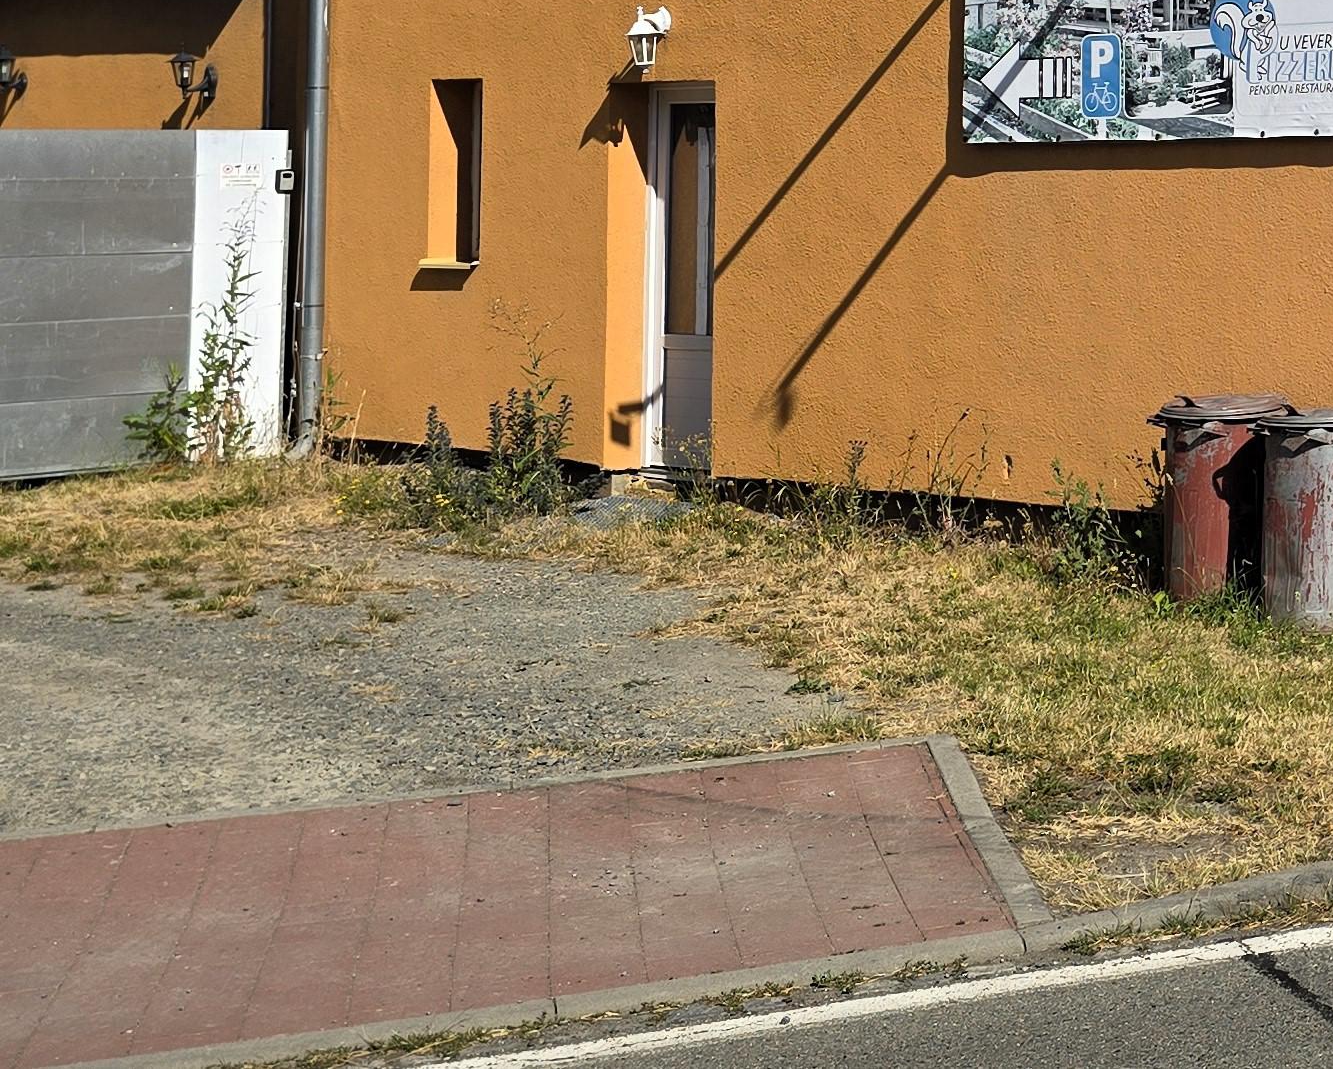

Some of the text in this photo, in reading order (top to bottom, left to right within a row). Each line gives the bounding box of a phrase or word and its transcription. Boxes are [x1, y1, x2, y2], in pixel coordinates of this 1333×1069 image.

[1279, 35, 1290, 50] U
[1091, 41, 1114, 78] P
[1249, 84, 1288, 95] PENSION
